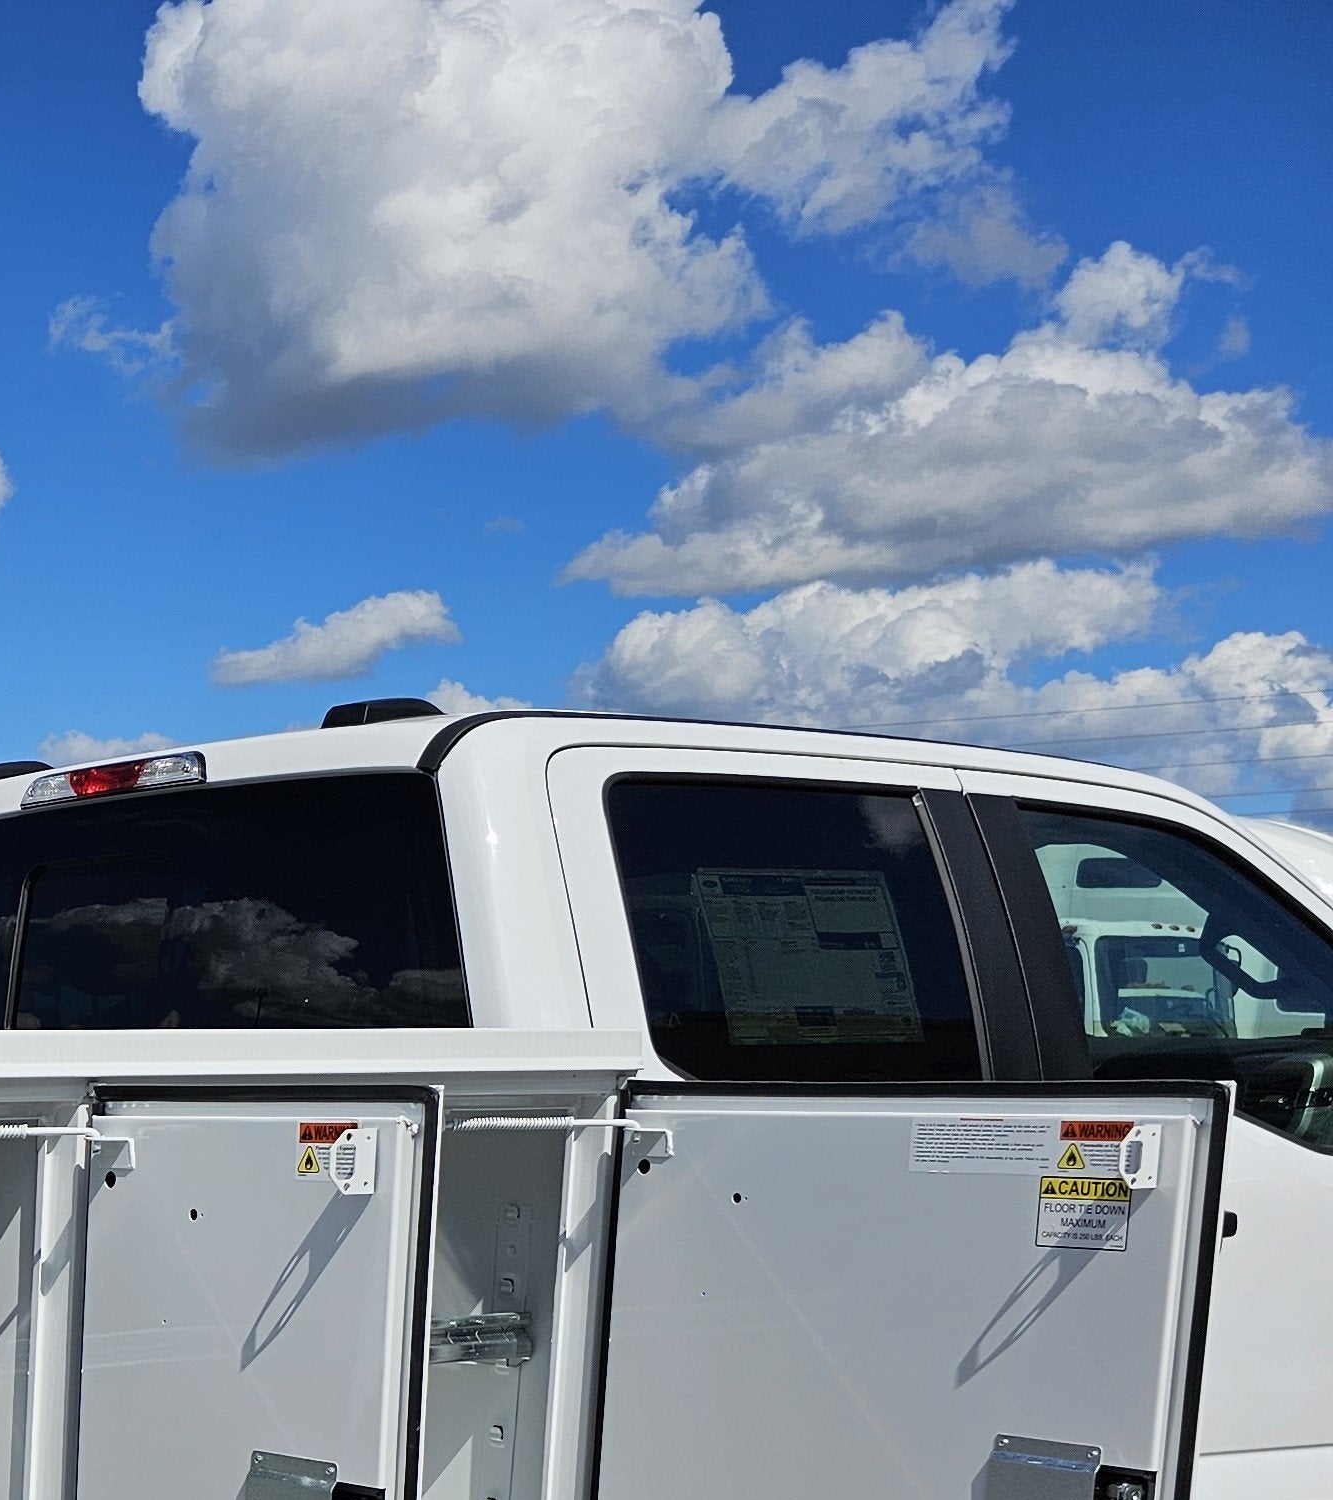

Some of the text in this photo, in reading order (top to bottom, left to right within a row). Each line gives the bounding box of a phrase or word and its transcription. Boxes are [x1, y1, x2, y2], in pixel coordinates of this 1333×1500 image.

[1078, 1124, 1133, 1139] WARNING
[1058, 1180, 1129, 1198] CAUTION
[1044, 1203, 1126, 1215] FLOOR TIE DOWN
[1060, 1217, 1106, 1228] MAXIMUM
[1041, 1231, 1071, 1240] CAPACITY
[1071, 1232, 1078, 1240] IS
